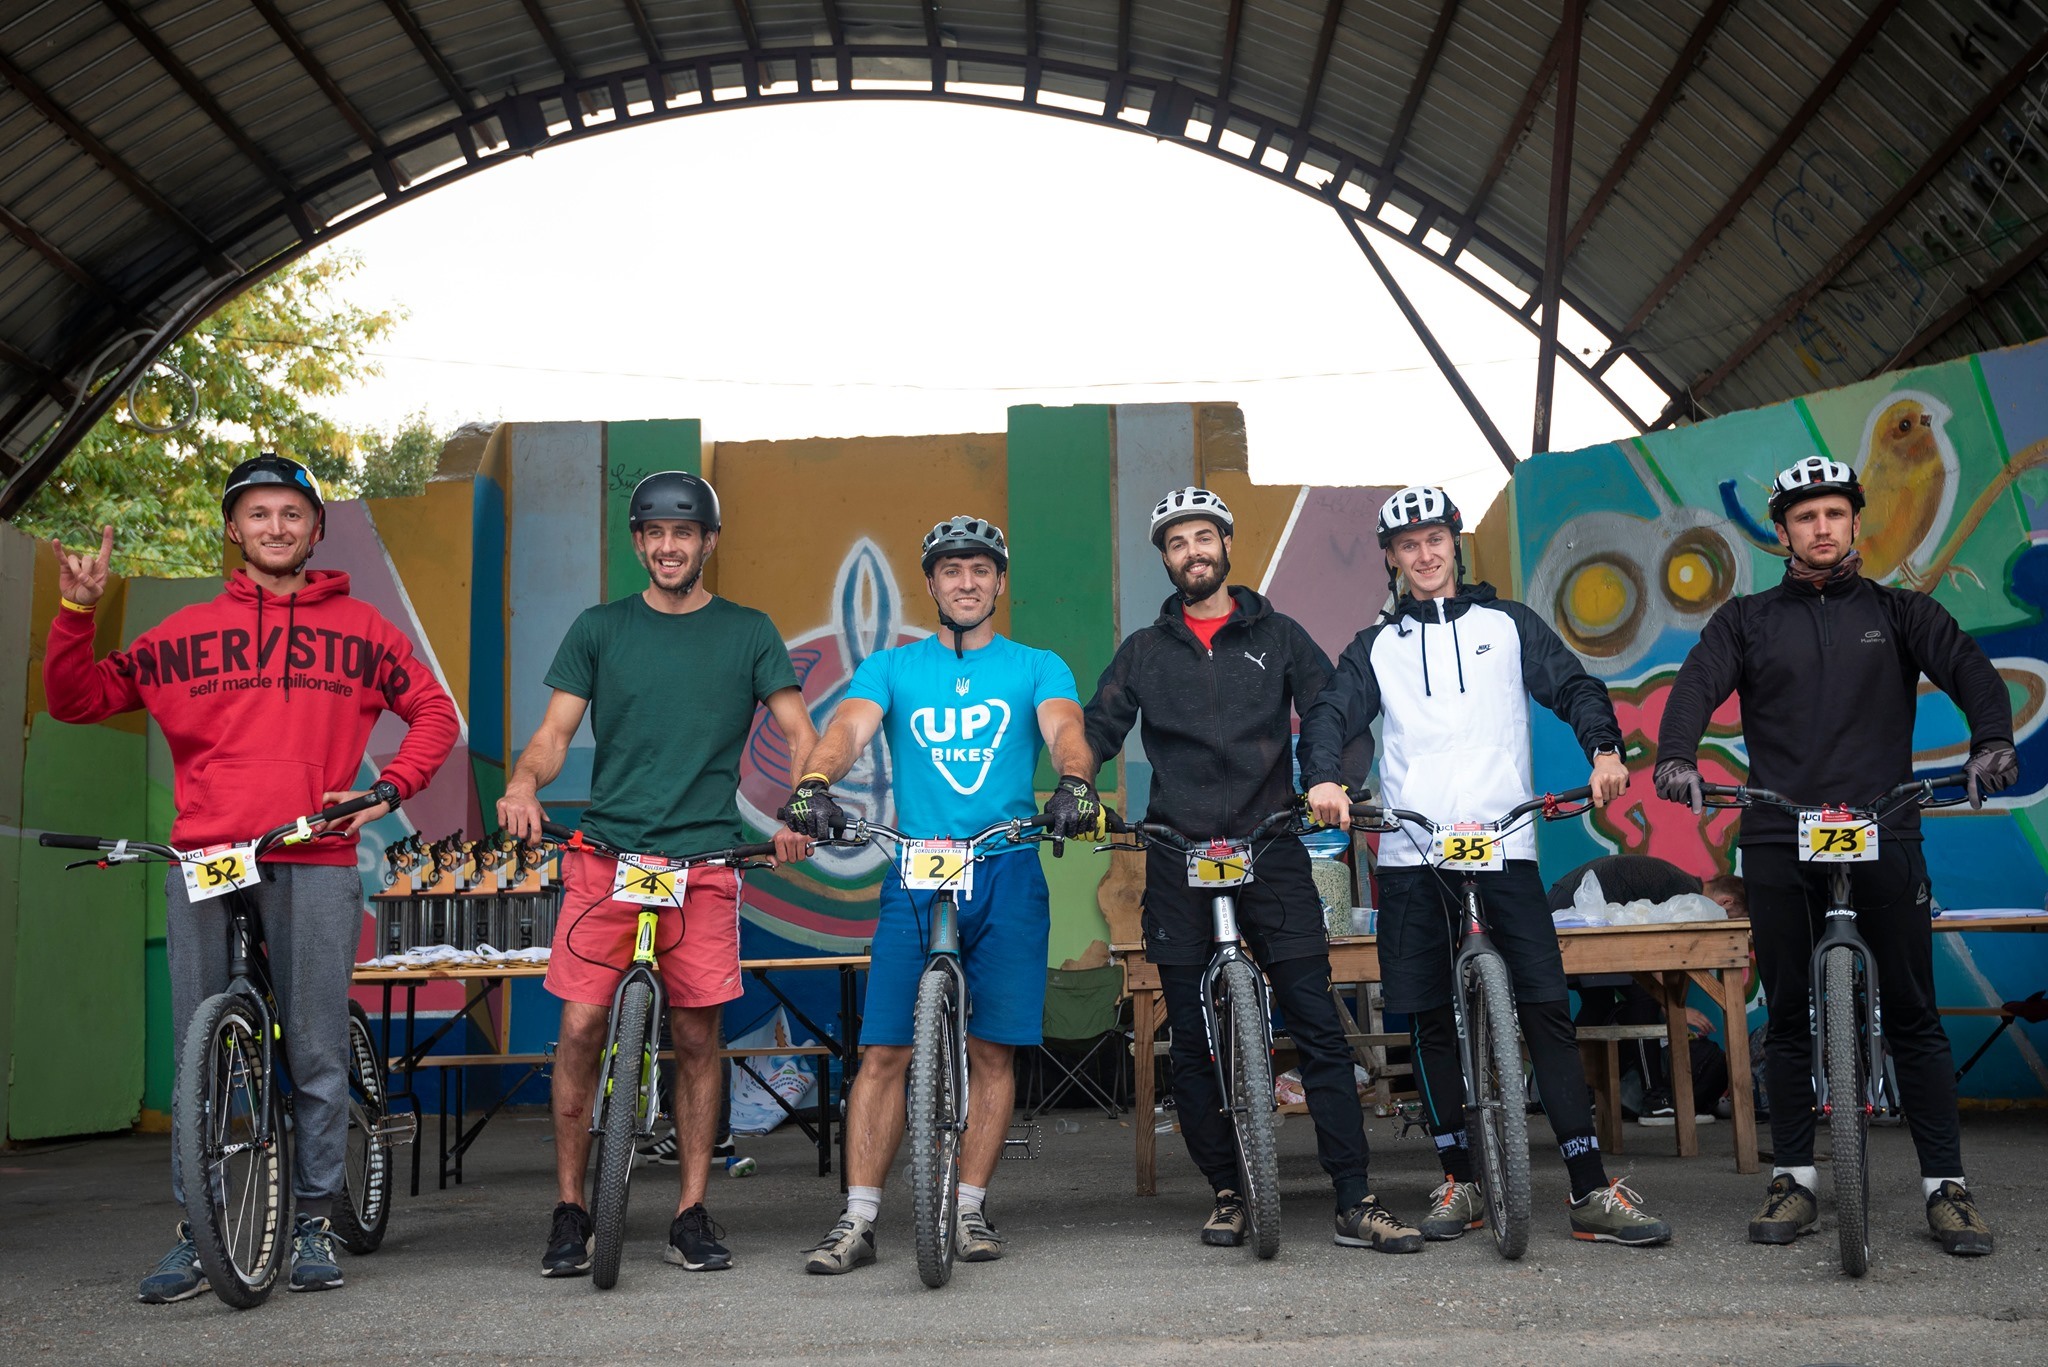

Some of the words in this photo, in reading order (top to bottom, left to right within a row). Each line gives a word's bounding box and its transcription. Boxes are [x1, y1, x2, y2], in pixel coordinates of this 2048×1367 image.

[108, 625, 411, 708] NNER/STONR
[189, 679, 219, 697] self
[223, 675, 272, 691] made
[277, 674, 353, 698] milionaire
[923, 704, 991, 742] UP
[931, 747, 995, 762] BIKES
[1452, 838, 1484, 860] 35
[1819, 829, 1857, 851] 73
[186, 851, 203, 860] UCI
[929, 855, 945, 878] 2
[206, 856, 240, 886] 52
[1214, 862, 1225, 879] 1
[640, 872, 658, 894] 4
